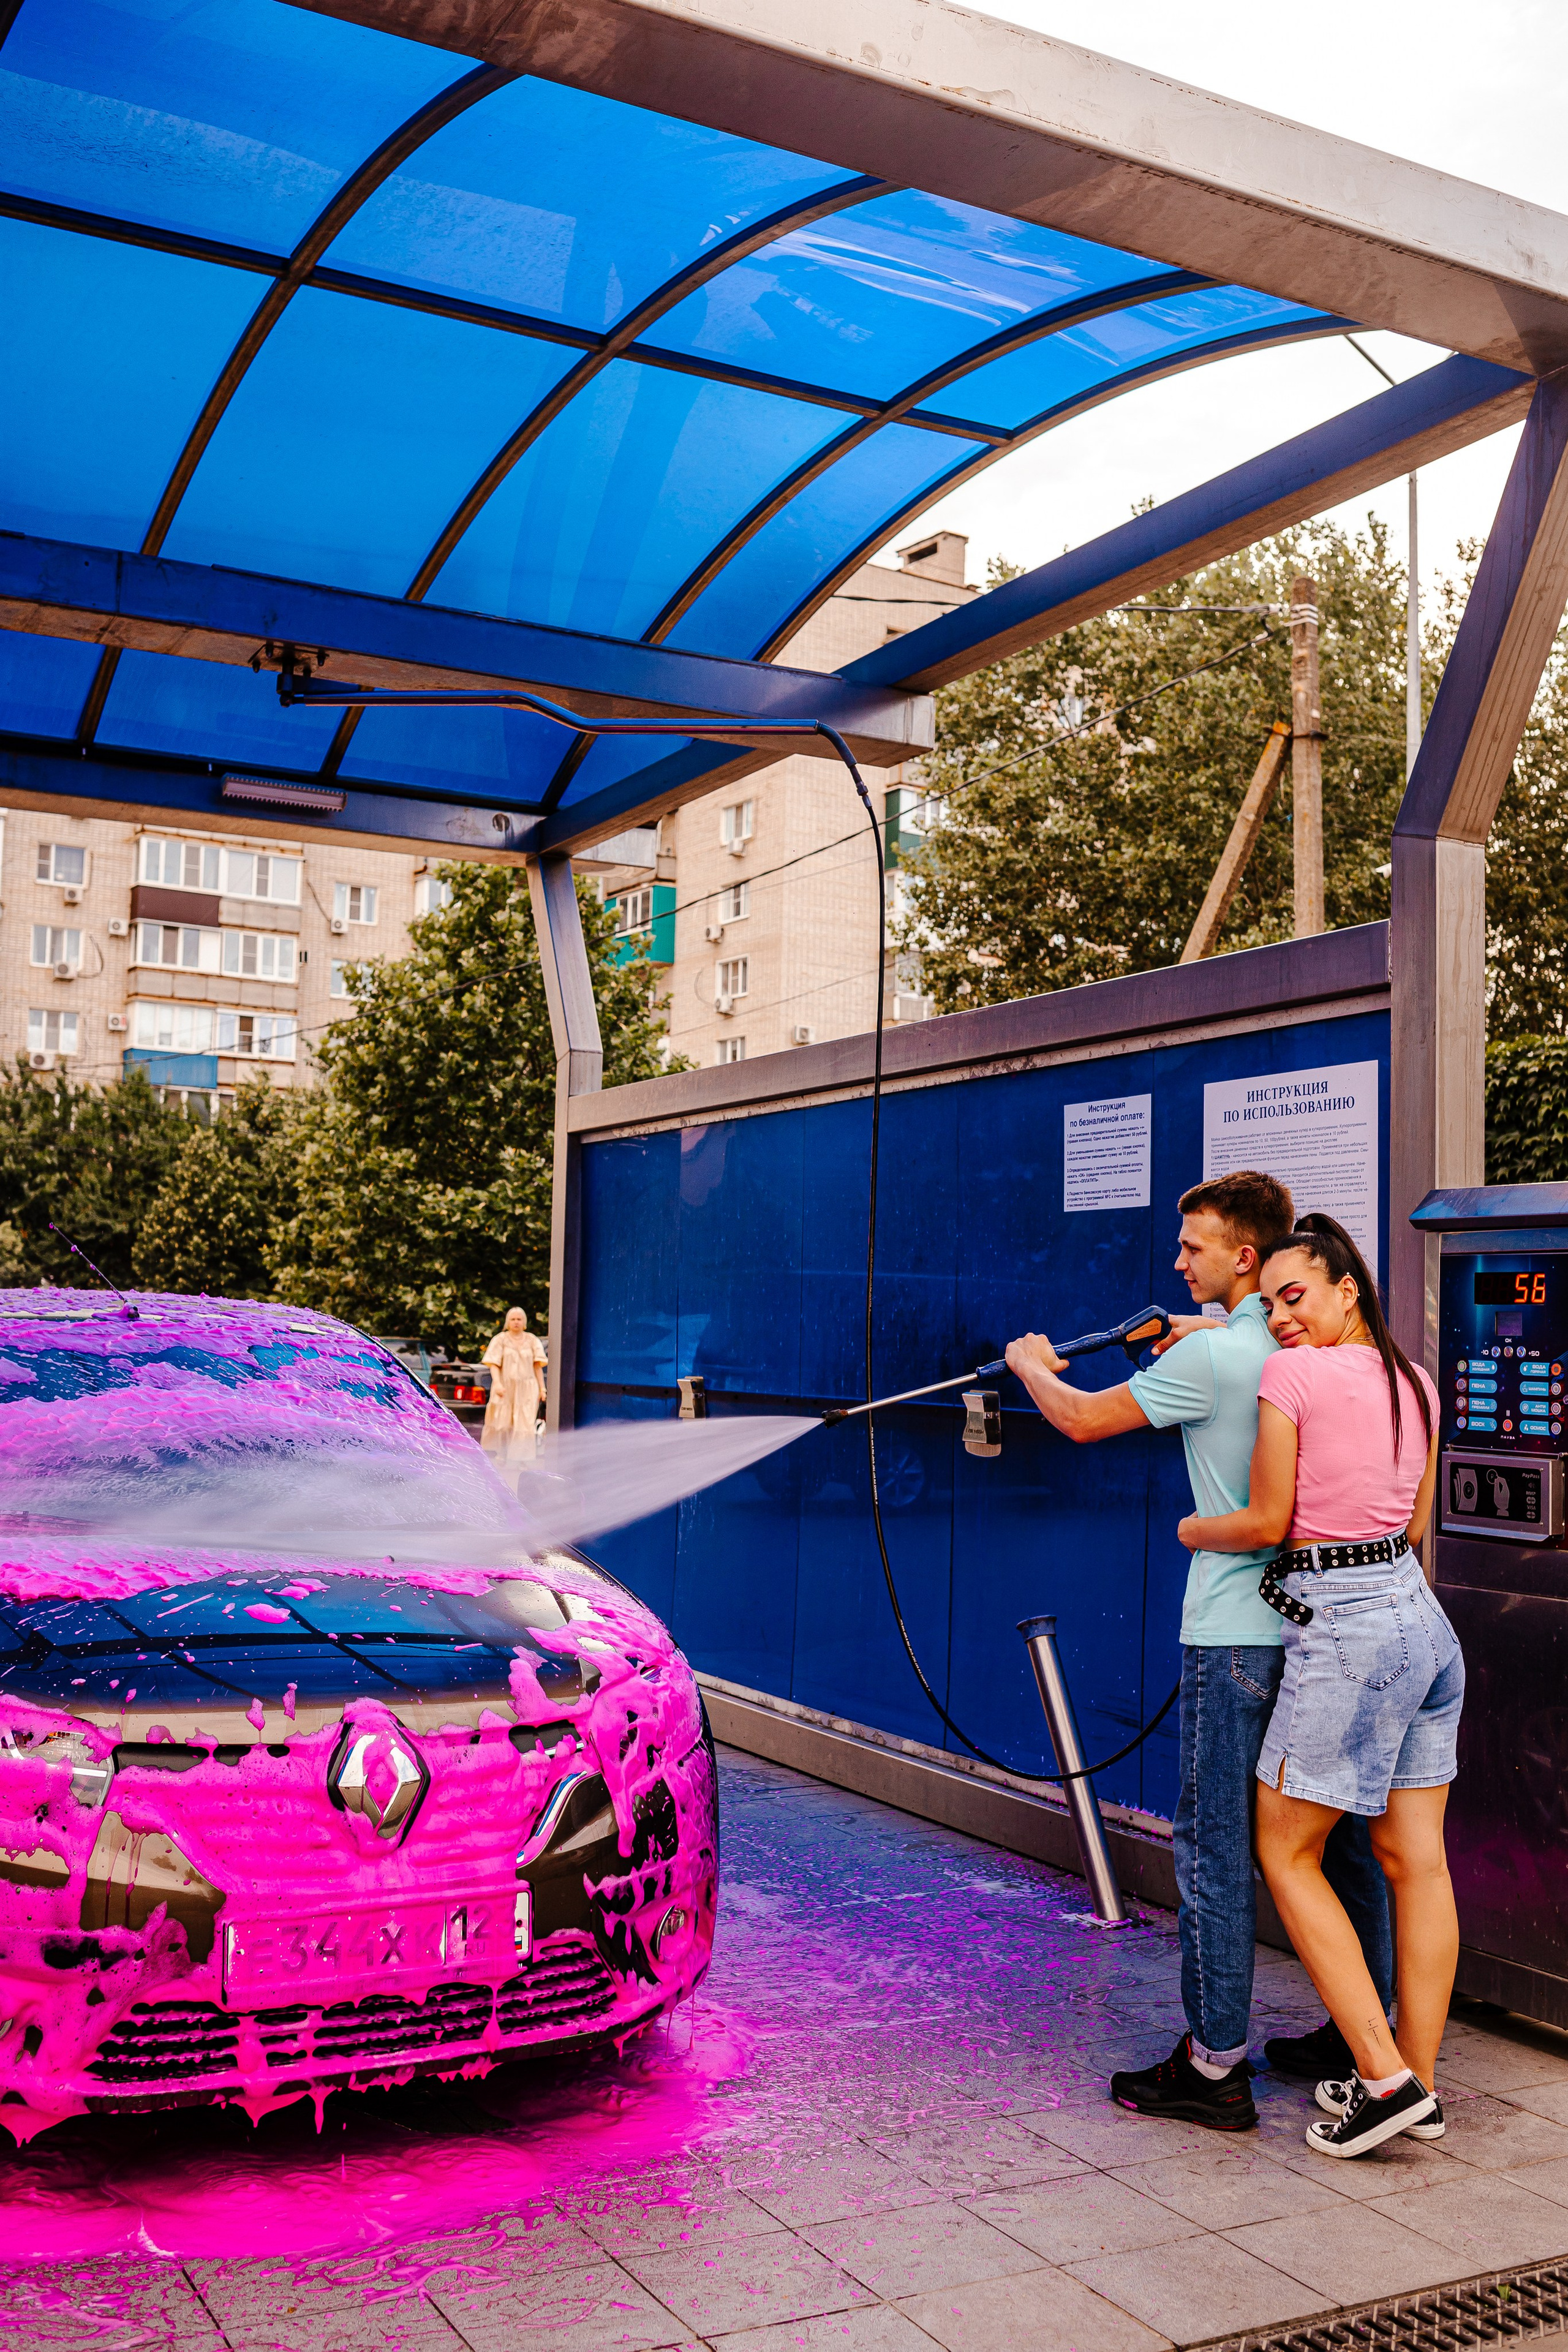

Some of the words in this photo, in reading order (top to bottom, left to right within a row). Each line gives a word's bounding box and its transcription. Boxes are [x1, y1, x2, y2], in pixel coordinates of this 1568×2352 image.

[1247, 1081, 1328, 1103] ИНСТРУКЦИЯ
[1088, 1102, 1125, 1113] Инструкция
[1224, 1110, 1239, 1123] ПО
[1243, 1096, 1355, 1121] ИСПОЛЬЗОВАНИЮ
[1079, 1114, 1119, 1126] безналичной
[1120, 1112, 1145, 1121] оплате:
[1514, 1273, 1545, 1303] 56
